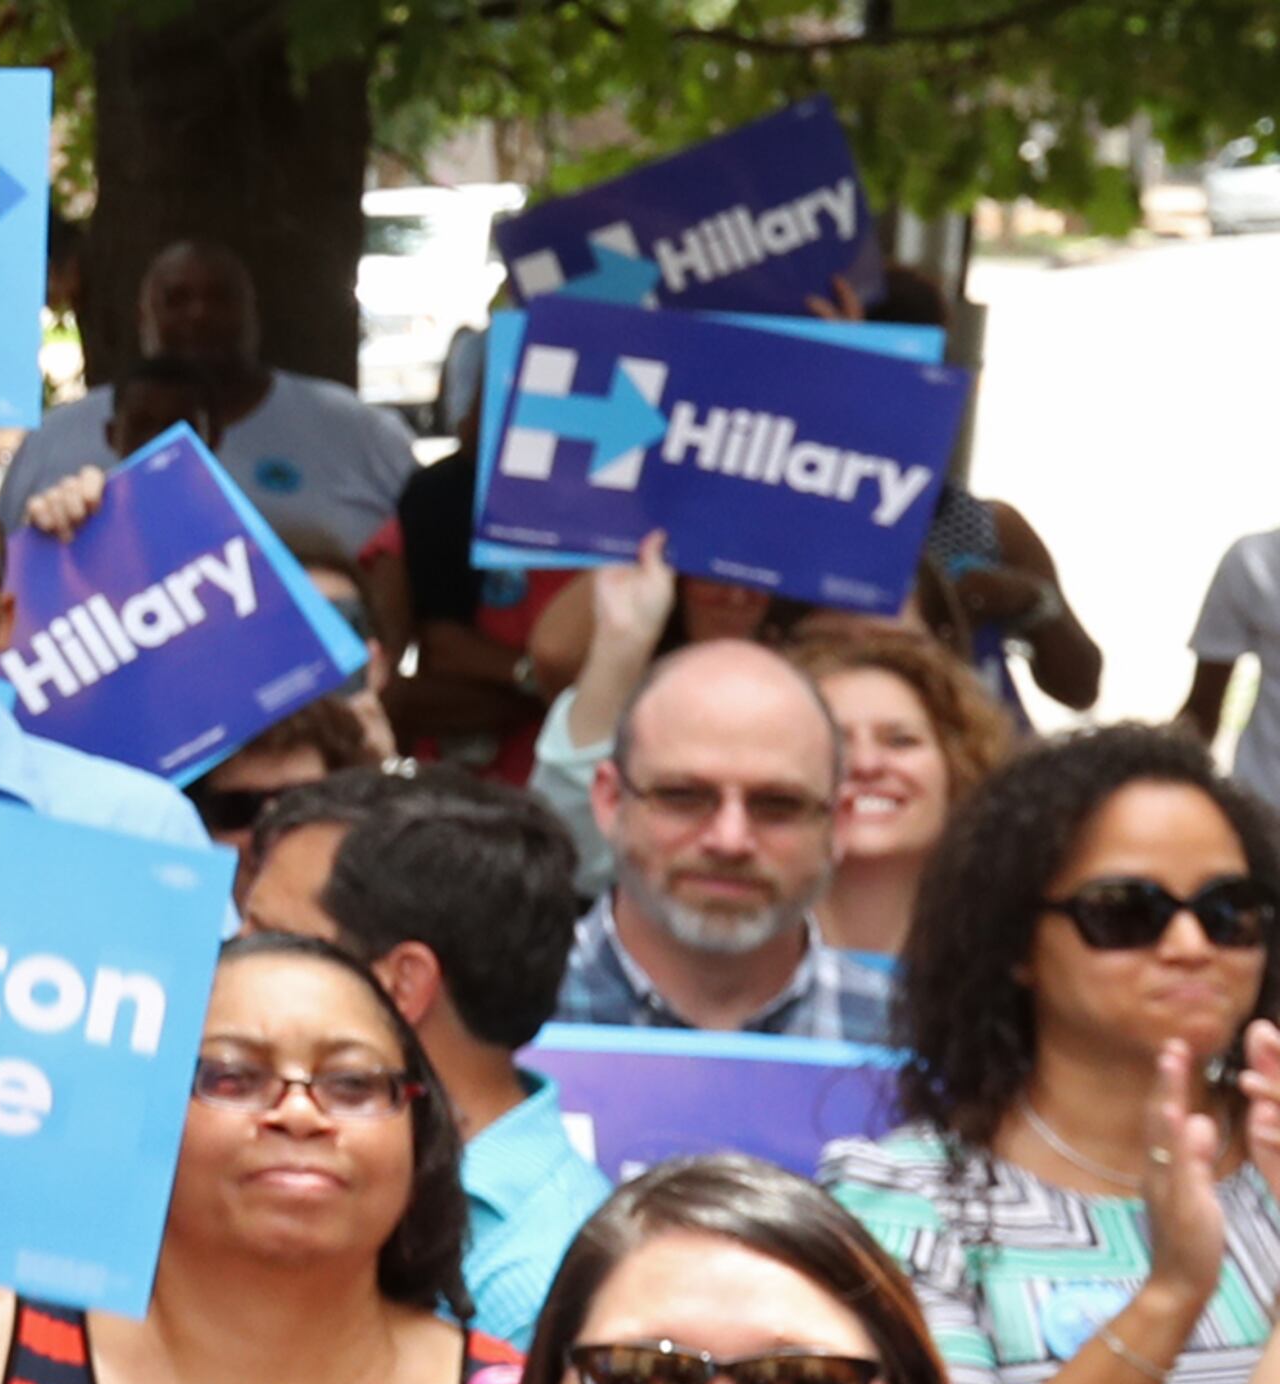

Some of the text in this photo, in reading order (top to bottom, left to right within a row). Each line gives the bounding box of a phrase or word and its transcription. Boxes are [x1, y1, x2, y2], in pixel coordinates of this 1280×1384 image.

[655, 178, 857, 292] Hillary
[661, 401, 932, 527] Hillary
[0, 535, 258, 716] Hillary
